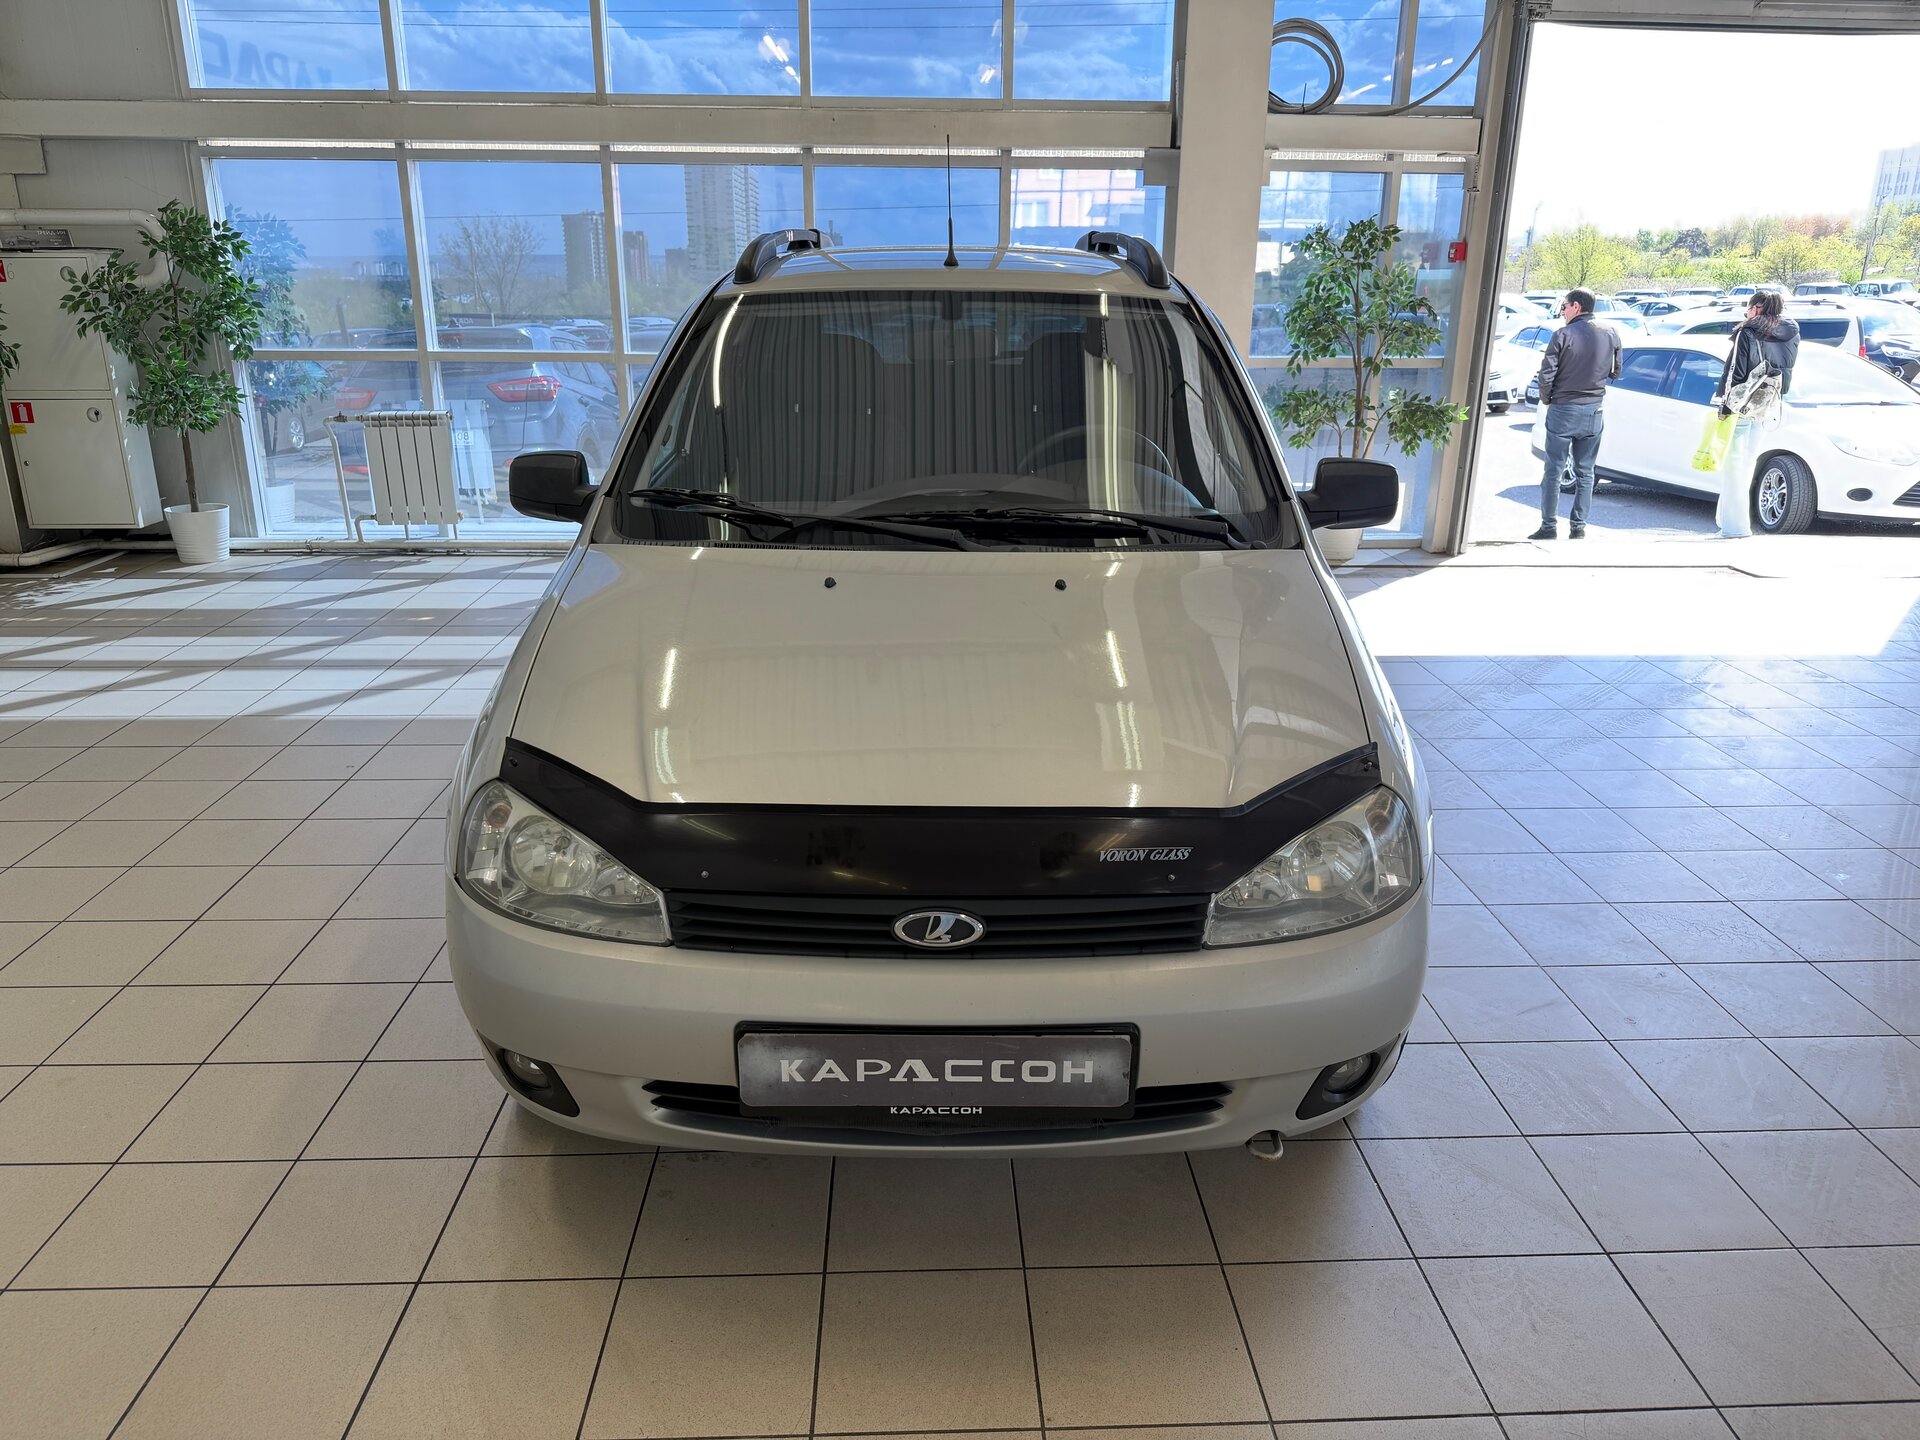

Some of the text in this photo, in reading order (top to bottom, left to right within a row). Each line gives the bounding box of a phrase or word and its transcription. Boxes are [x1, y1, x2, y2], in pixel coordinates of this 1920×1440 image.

[6, 262, 15, 280] 6
[1099, 848, 1193, 862] VORON GLASS
[779, 1058, 1095, 1084] КАРАССОН
[890, 1106, 983, 1115] КАРАССОН
